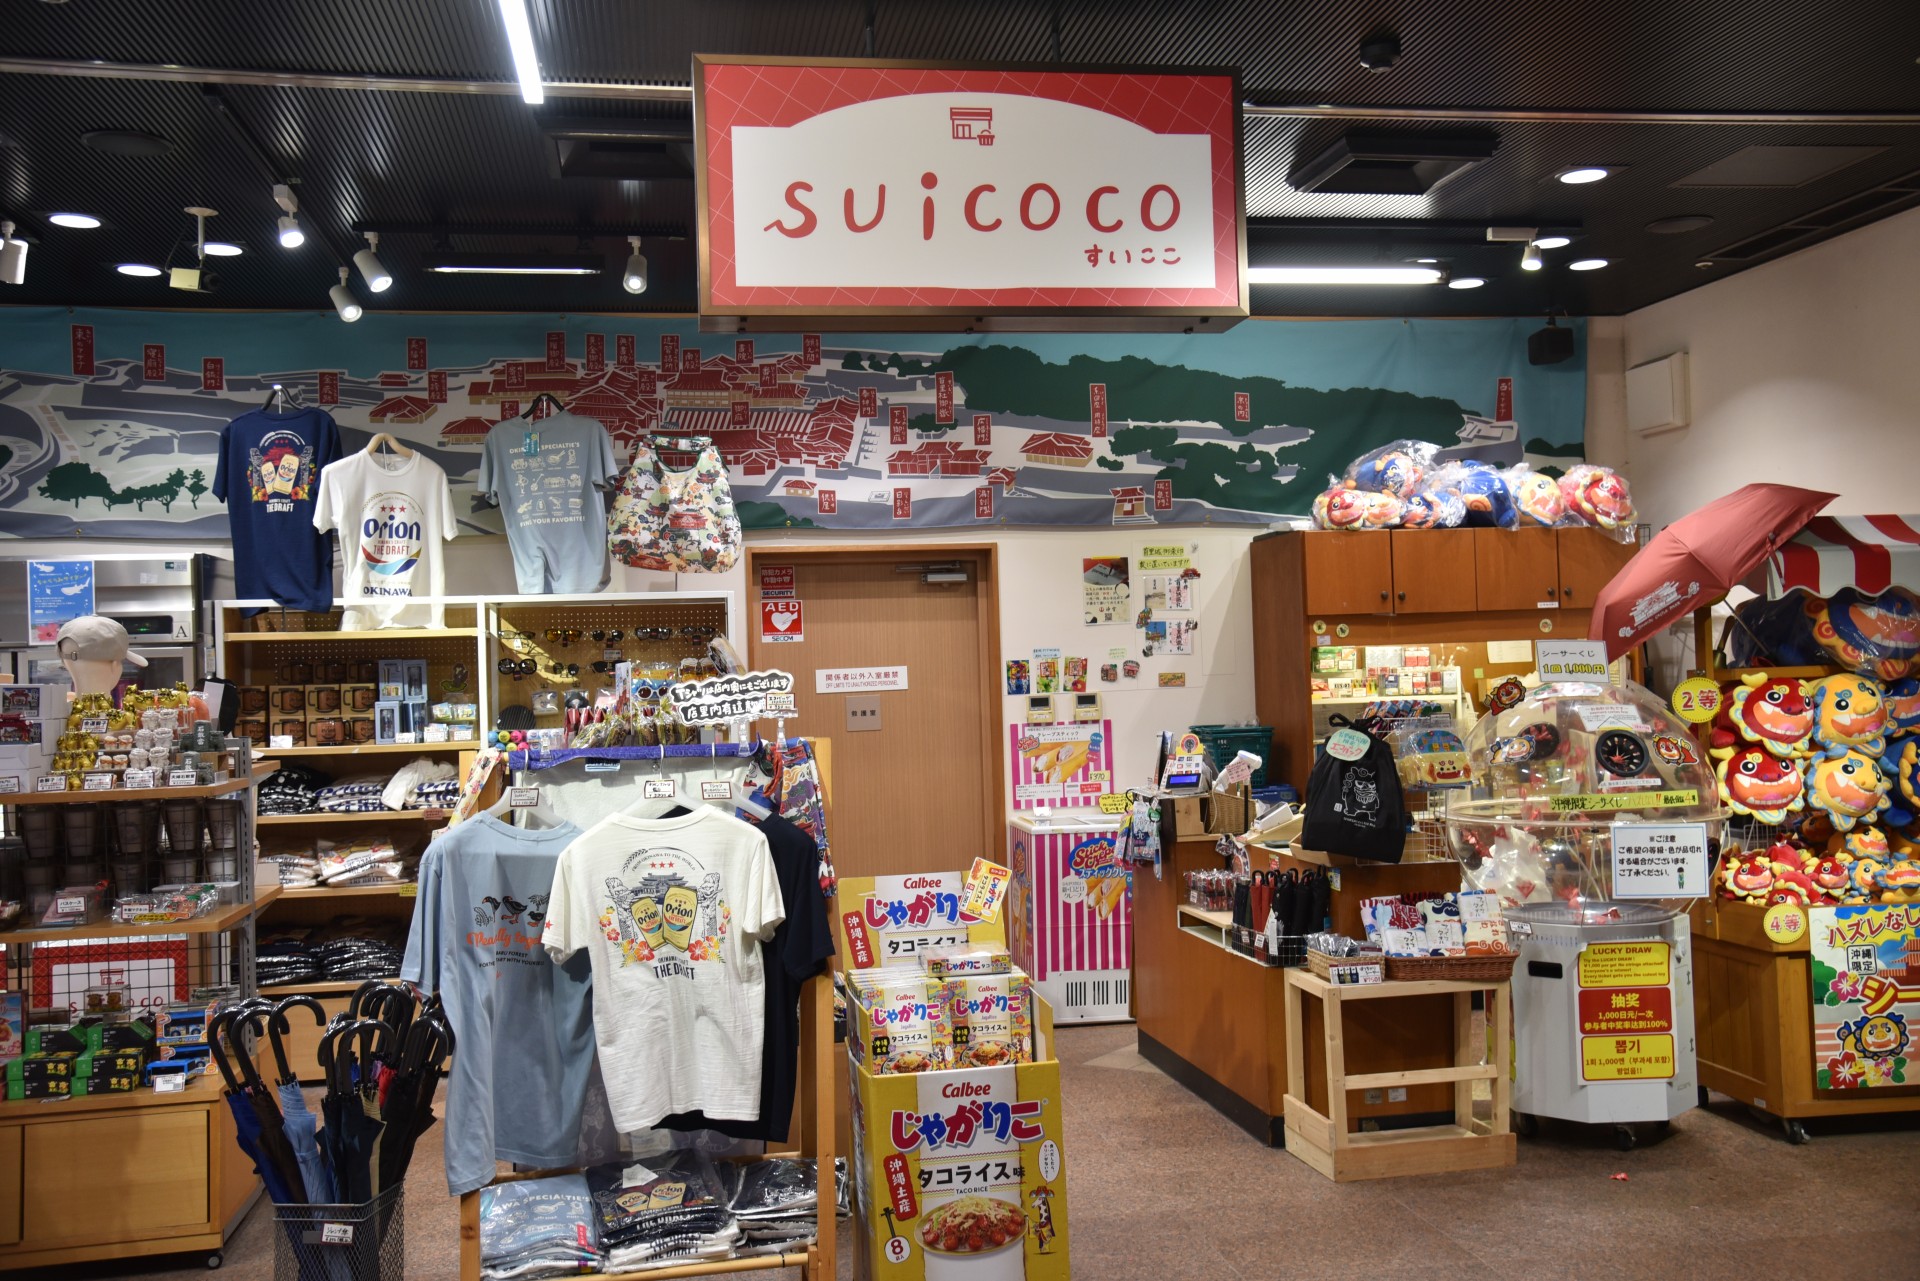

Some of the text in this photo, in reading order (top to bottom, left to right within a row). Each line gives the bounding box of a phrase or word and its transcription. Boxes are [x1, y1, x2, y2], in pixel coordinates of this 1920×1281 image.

[1084, 244, 1182, 268] すいここ
[738, 344, 748, 361] 書院
[684, 352, 695, 369] 南殿
[640, 374, 651, 391] 正殿
[734, 405, 744, 421] 御庭
[1237, 396, 1246, 417] 京の内
[892, 410, 902, 443] 下之御庭
[541, 442, 580, 450] SPECIALTIE'S
[281, 464, 296, 474] Orion
[275, 503, 294, 512] DRAFT
[364, 514, 421, 540] Orion
[374, 544, 410, 556] THE DRAFT
[363, 586, 412, 596] OKINAWA
[765, 602, 798, 612] AED
[176, 625, 187, 638] A
[1543, 663, 1605, 674] 1回 1,000円
[826, 672, 898, 682] 関係者以外入室厳禁
[676, 678, 788, 700] Tシャツは店内奥にもございます
[1682, 690, 1718, 710] 2等
[1090, 773, 1106, 781] ¥370
[1618, 846, 1702, 855] ご希望の等級・色が品切れ
[642, 853, 663, 863] OKINAWA
[682, 857, 696, 870] WORLD
[1618, 868, 1670, 878] ご了承ください。
[904, 878, 942, 890] Calbee
[983, 877, 1000, 910] じゃがりこ
[638, 910, 659, 926] Orion
[666, 904, 692, 918] Orion
[1770, 913, 1800, 932] 4等
[1828, 907, 1920, 946] ハズレなし
[848, 916, 868, 964] 沖縄土産
[1851, 948, 1872, 960] 沖縄
[654, 964, 671, 978] THE
[946, 960, 980, 971] じゃがりこ
[1852, 961, 1874, 972] 限定
[955, 994, 1021, 1016] じゃがりこ
[1611, 993, 1640, 1008] 抽奖
[874, 1002, 941, 1025] じゃがりこ
[1598, 1010, 1654, 1020] 1,000日元/一次
[1584, 1020, 1668, 1030] 参与者中奖率达到100%
[1615, 1039, 1641, 1054] 뽑기
[942, 1082, 991, 1098] Calbee
[890, 1100, 1044, 1150] じゃがりこ
[917, 1162, 1025, 1188] タコライス味
[654, 1187, 683, 1197] Orion
[890, 1160, 912, 1214] 沖縄土産
[890, 1240, 904, 1256] 8
